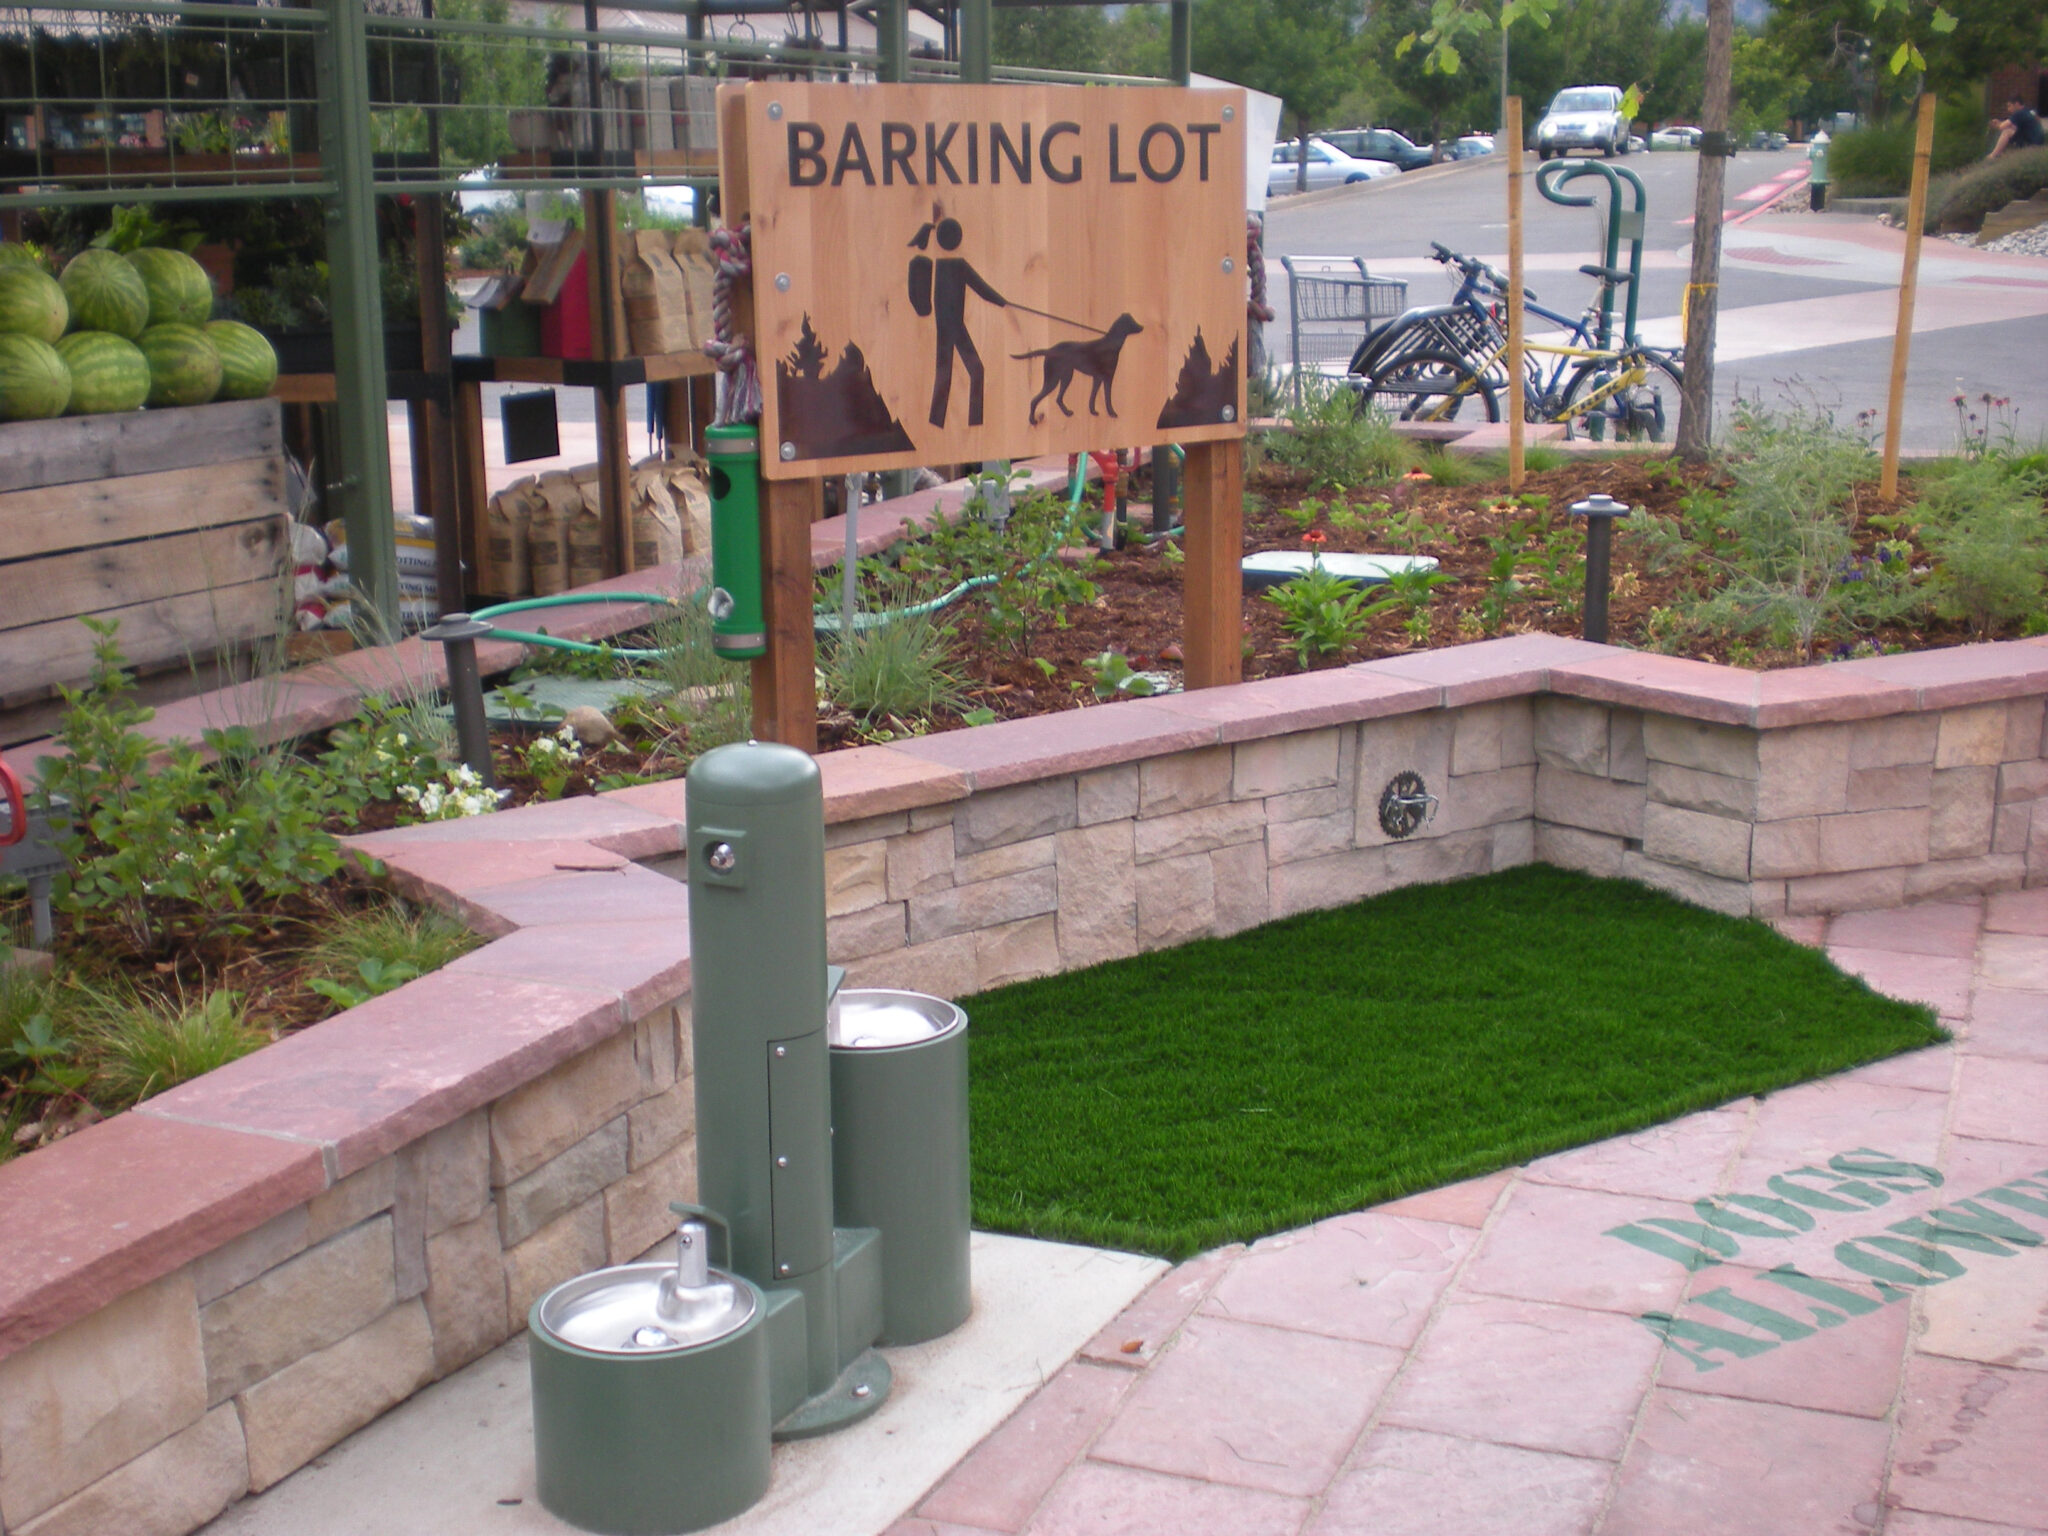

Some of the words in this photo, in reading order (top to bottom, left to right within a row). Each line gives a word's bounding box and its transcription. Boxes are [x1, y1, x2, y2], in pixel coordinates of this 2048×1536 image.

[786, 120, 1083, 188] BARKING
[1109, 121, 1222, 185] LOT
[397, 556, 431, 567] OTTING
[1601, 1147, 1944, 1272] DOGS
[1632, 1169, 2048, 1372] ALLOWE
